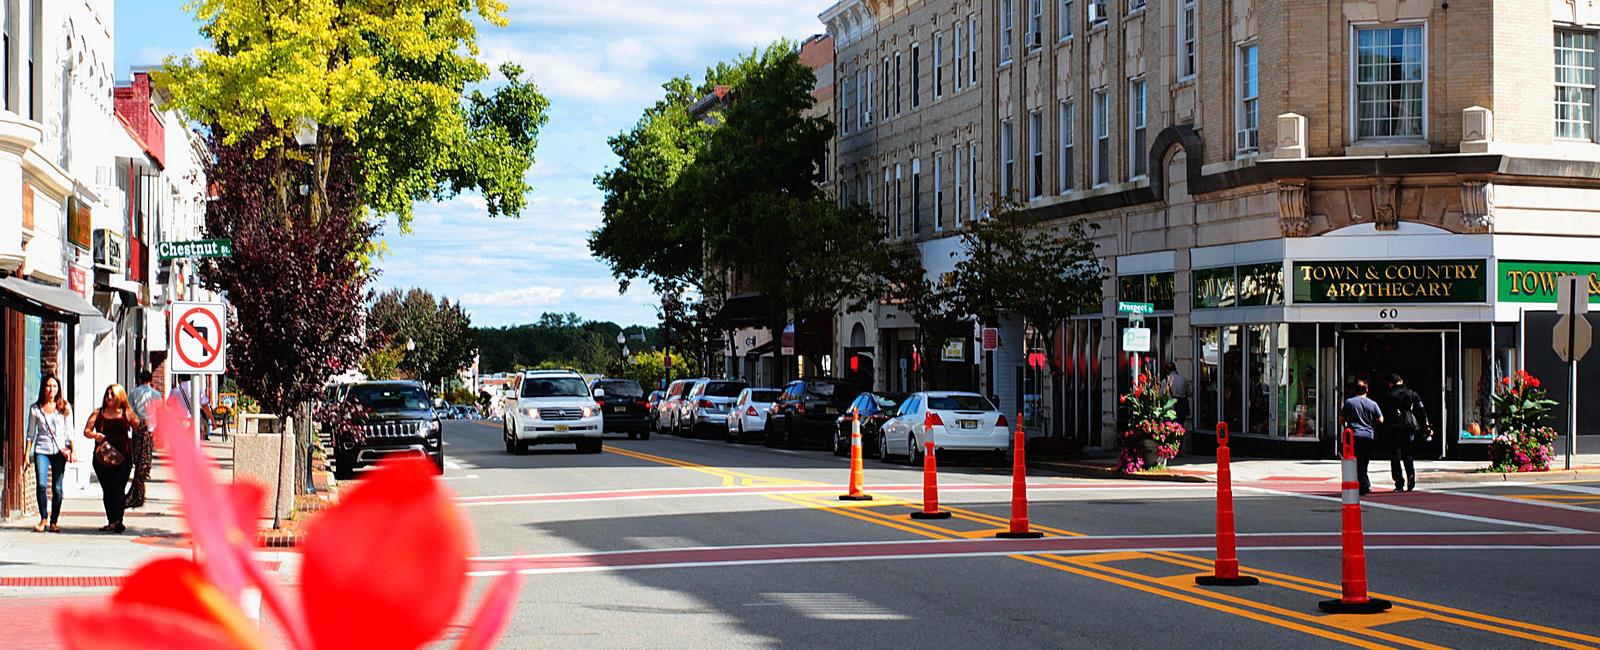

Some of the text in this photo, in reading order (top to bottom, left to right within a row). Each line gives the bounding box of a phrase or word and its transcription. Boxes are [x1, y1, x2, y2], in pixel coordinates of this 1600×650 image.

[160, 241, 218, 257] Chestnut
[1301, 264, 1480, 281] TOWN & COUNTRY
[1326, 282, 1453, 297] APOTHECARY
[1507, 270, 1576, 294] TOW
[1119, 302, 1148, 313] Prospect
[1380, 308, 1398, 319] 60
